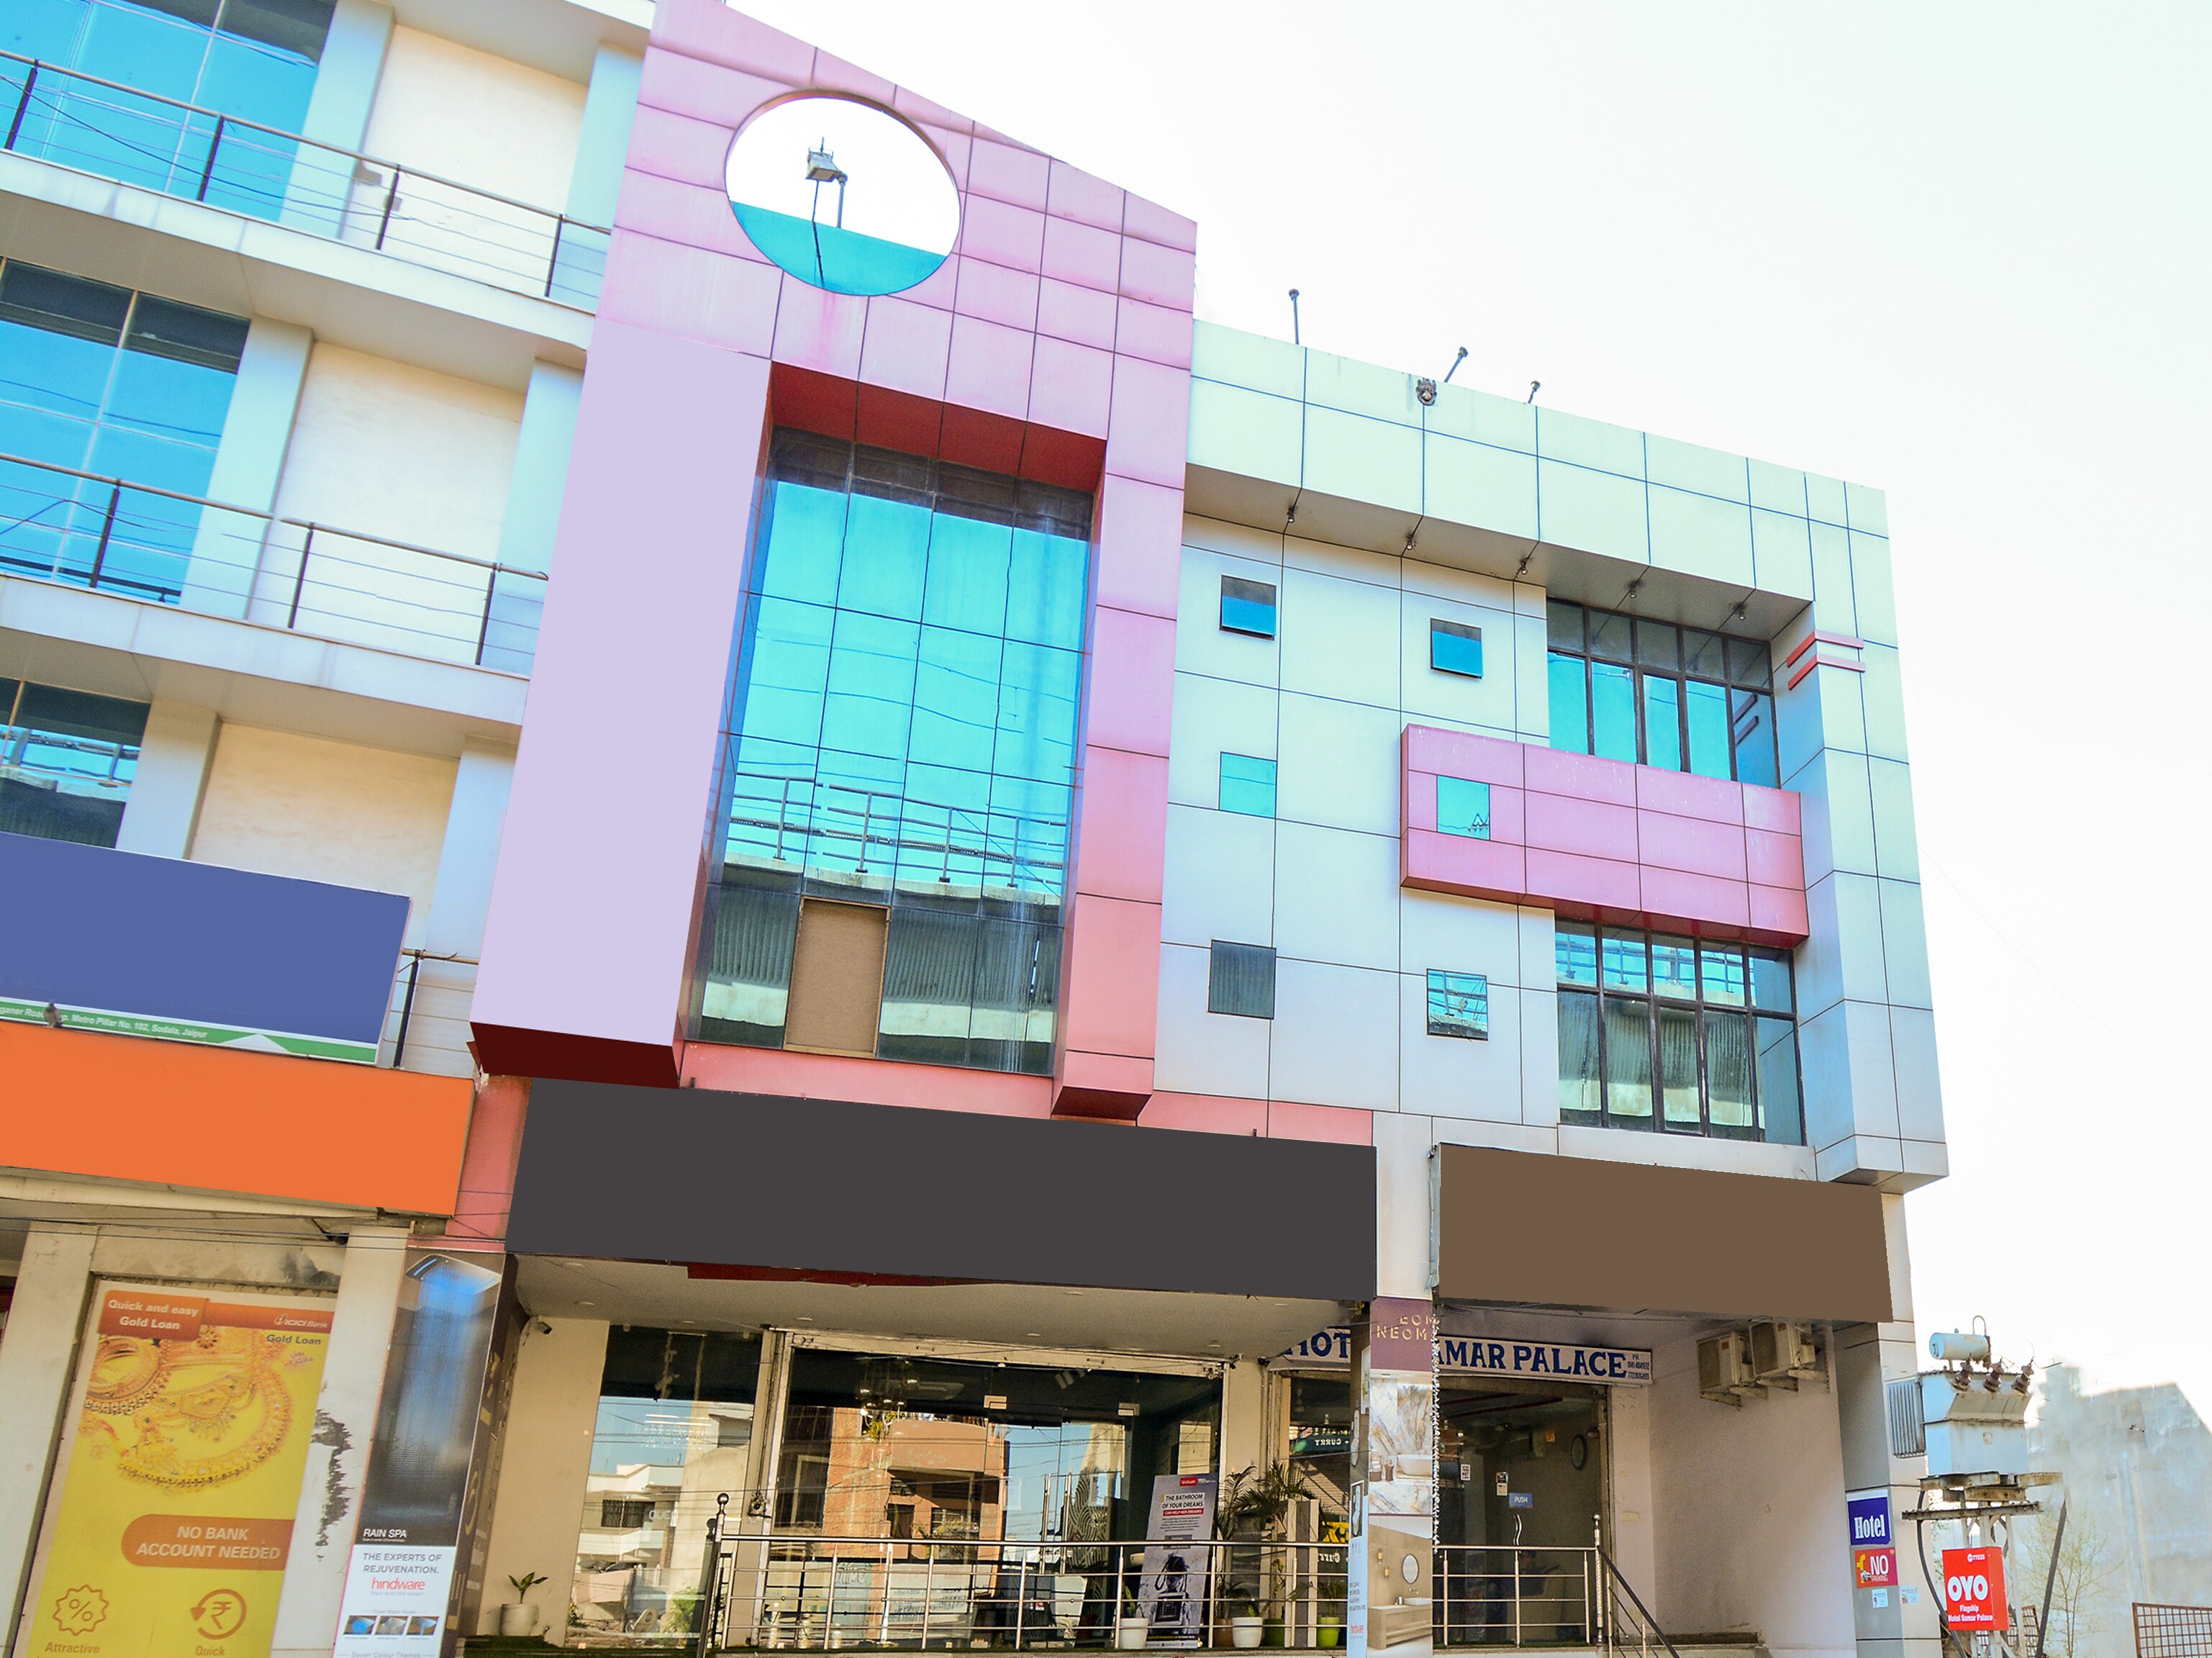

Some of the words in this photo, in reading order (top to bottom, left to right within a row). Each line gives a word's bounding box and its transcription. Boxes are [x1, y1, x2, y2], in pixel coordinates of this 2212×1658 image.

[24, 1008, 45, 1018] Roa
[71, 1014, 94, 1024] Metro
[96, 1018, 117, 1027] Pillar
[118, 1020, 132, 1029] No.
[182, 1028, 208, 1038] Jaipur
[108, 1300, 143, 1311] Quick
[145, 1304, 169, 1313] and
[171, 1307, 199, 1318] easy
[119, 1316, 149, 1327] Gold
[150, 1319, 181, 1330] Loan
[266, 1333, 293, 1344] Gold
[295, 1336, 322, 1345] Loan
[1377, 1325, 1427, 1341] NEOM
[1513, 1345, 1628, 1378] PALACE
[177, 1526, 201, 1539] NO
[205, 1528, 249, 1541] BANK
[363, 1528, 386, 1538] RAIN
[388, 1529, 407, 1538] SPA
[1854, 1514, 1886, 1539] Hotel
[136, 1543, 216, 1557] ACCOUNT
[218, 1546, 281, 1559] NEEDED
[384, 1553, 425, 1562] EXPERTS
[363, 1564, 439, 1574] REJUVENATION.
[1870, 1554, 1889, 1575] NO
[371, 1577, 426, 1590] hindware
[1947, 1575, 1988, 1602] OYO
[1959, 1604, 1980, 1613] Flagship
[45, 1641, 100, 1654] Attractive
[195, 1645, 225, 1657] Quick
